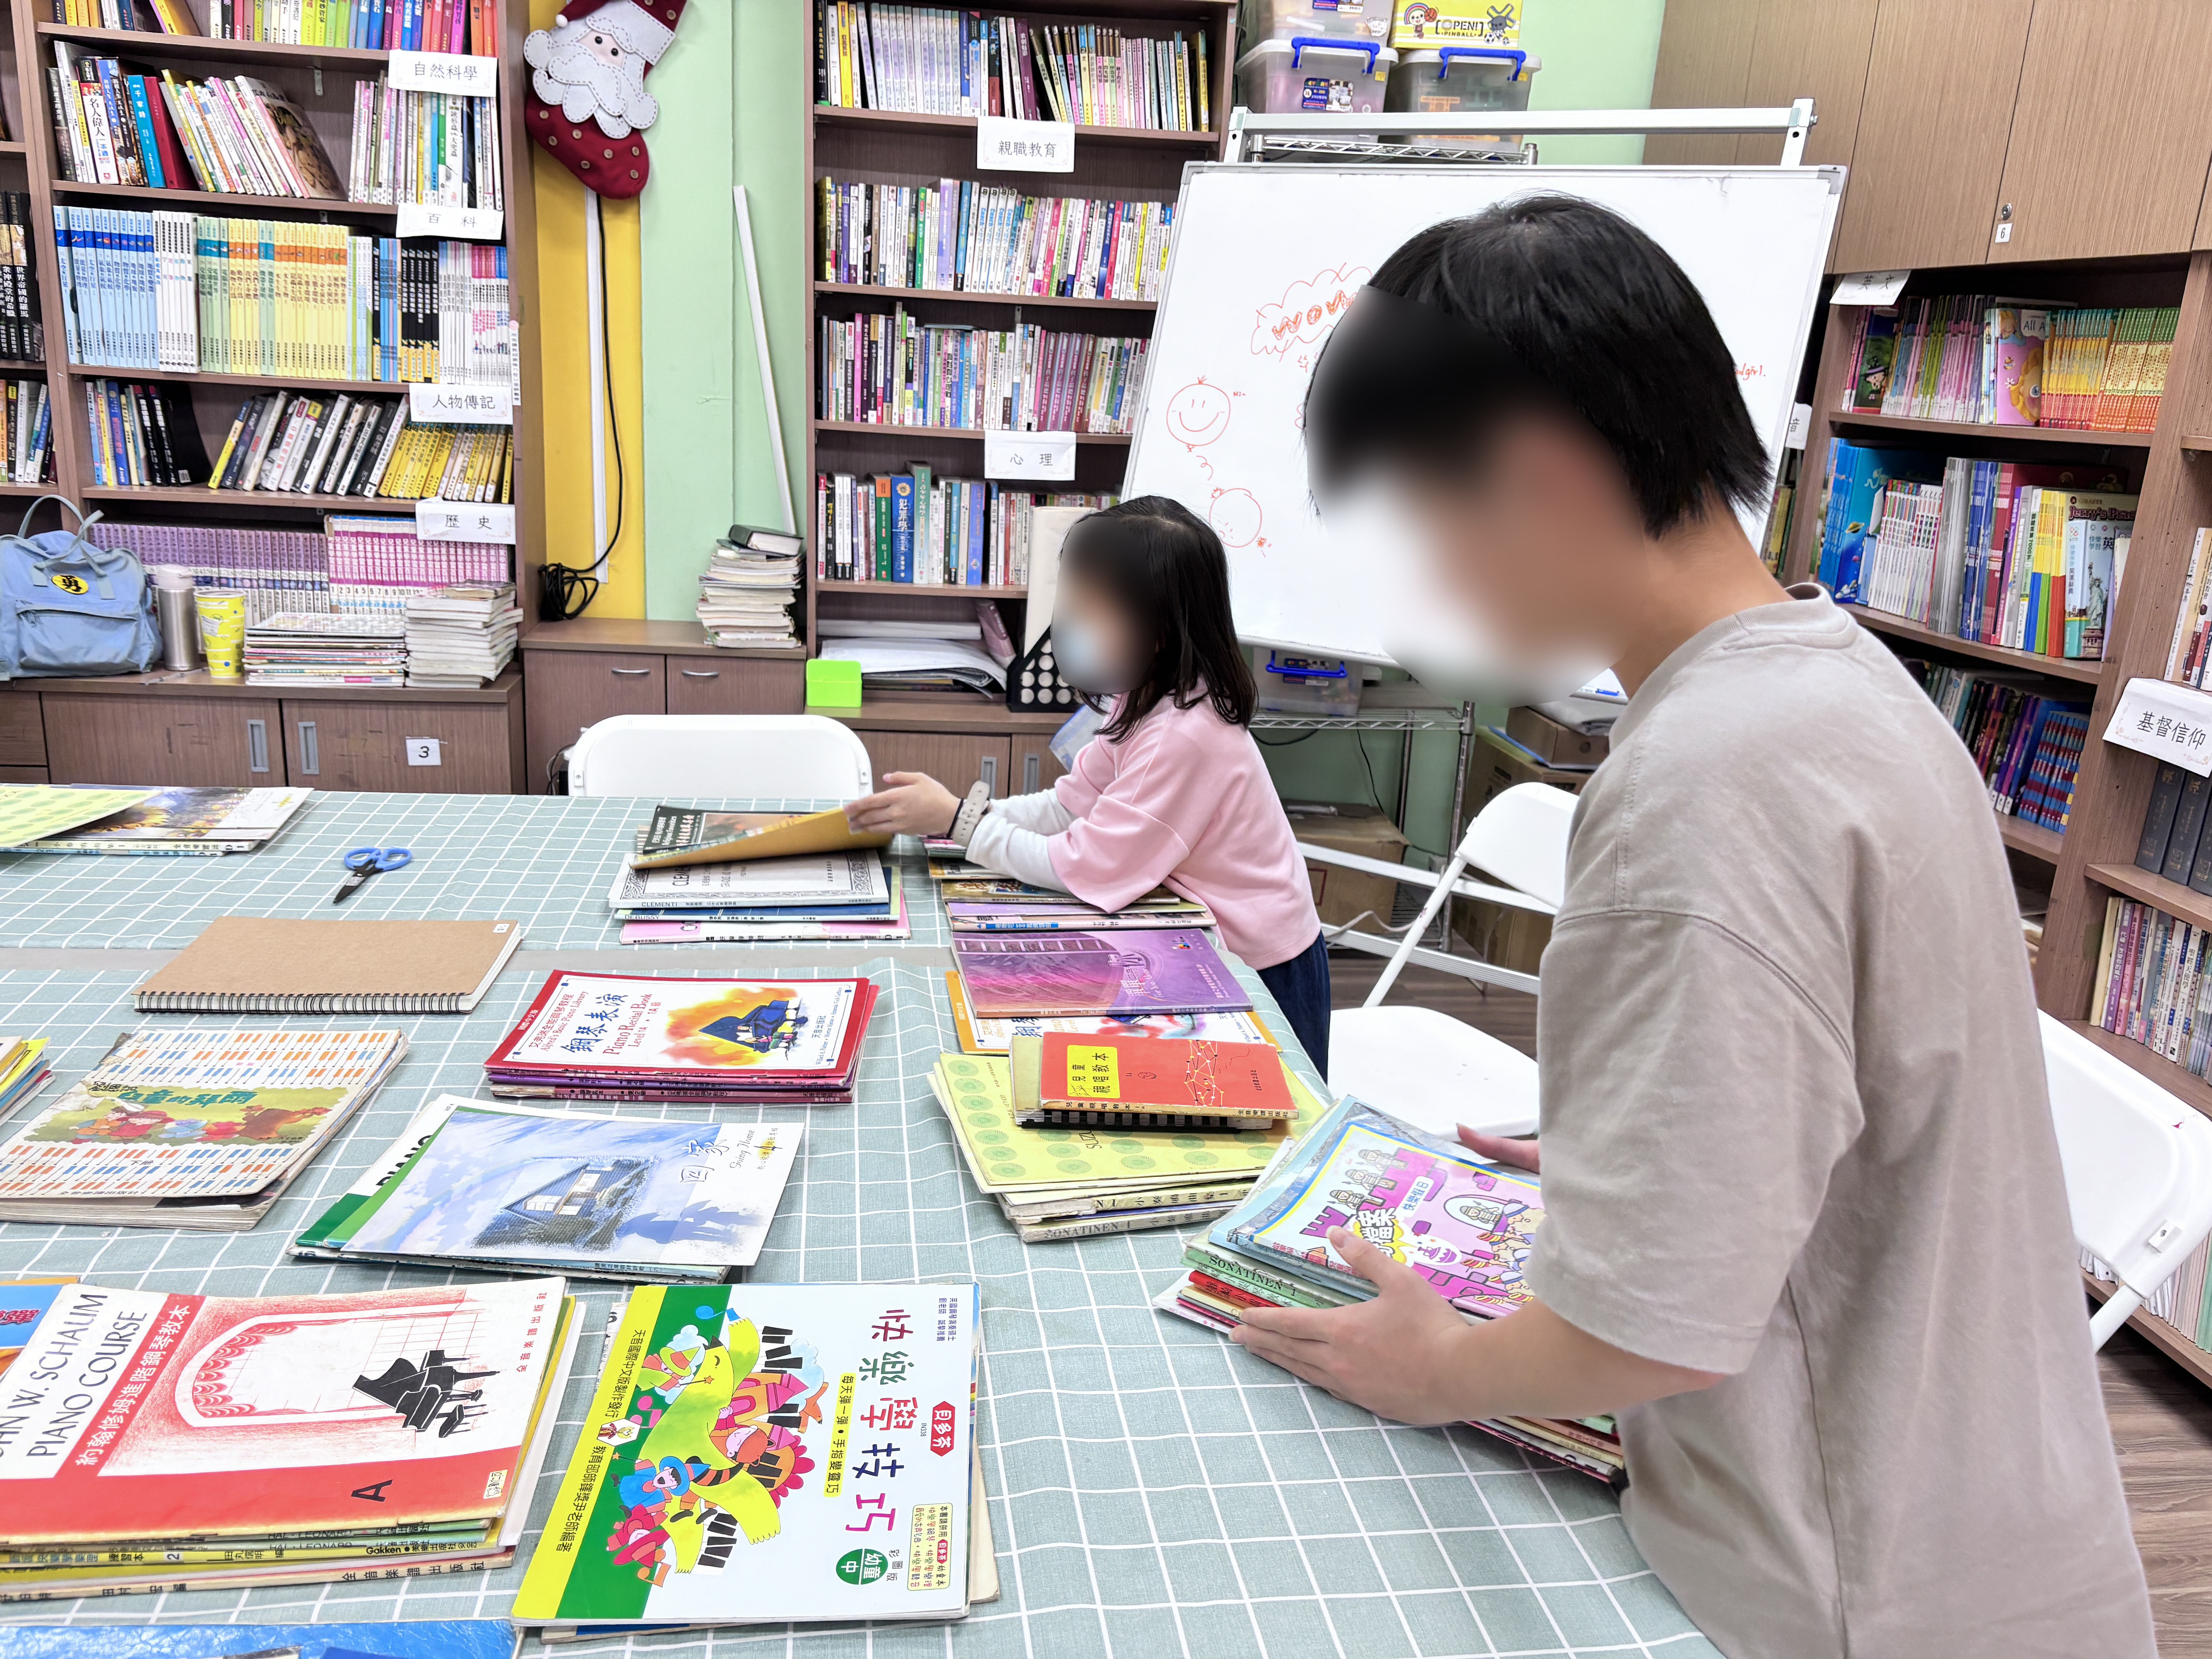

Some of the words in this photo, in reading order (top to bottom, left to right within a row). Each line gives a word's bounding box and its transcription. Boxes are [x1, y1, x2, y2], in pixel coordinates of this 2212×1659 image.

[415, 62, 478, 81] 自然科學
[89, 98, 105, 137] 名人偉人
[998, 140, 1056, 158] 親職教育
[428, 213, 476, 227] 百科
[16, 266, 29, 318] 世界帝國的羅馬
[1858, 274, 1894, 290] 英文
[2024, 321, 2036, 331] All
[432, 394, 495, 409] 人物傳記
[1010, 453, 1053, 466] 心理
[445, 515, 492, 529] 歷史
[2069, 505, 2107, 520] Jerry's
[2136, 710, 2207, 750] 基督信仰
[419, 746, 429, 757] 3
[630, 994, 653, 1009] Book
[553, 1018, 568, 1037] Basic
[562, 1008, 576, 1024] Piano
[560, 994, 629, 1053] 鋼琴表演
[618, 1011, 643, 1031] Recital
[603, 1032, 631, 1055] Piano
[628, 1032, 642, 1047] Level
[1072, 1064, 1086, 1082] 兒童
[1092, 1052, 1110, 1094] 視唱教本
[737, 1129, 755, 1149] Home
[730, 1149, 751, 1169] Going
[1045, 1221, 1119, 1239] SONATINEN
[1209, 1255, 1283, 1291] SONATINEN
[30, 1293, 109, 1381] SCHAUM
[517, 1291, 548, 1373] 全音樂譜出版社
[27, 1394, 93, 1457] PIANO
[79, 1311, 148, 1387] COURSE
[75, 1304, 191, 1467] 約翰修姆進階鋼琴教本
[15, 1387, 50, 1410] W.
[845, 1309, 918, 1533] 快樂學技巧
[932, 1408, 954, 1450] 貝多芬
[351, 1479, 393, 1502] A
[366, 1546, 402, 1554] Gakken
[342, 1561, 485, 1582] 全音樂譜出版社
[841, 1560, 859, 1573] 中
